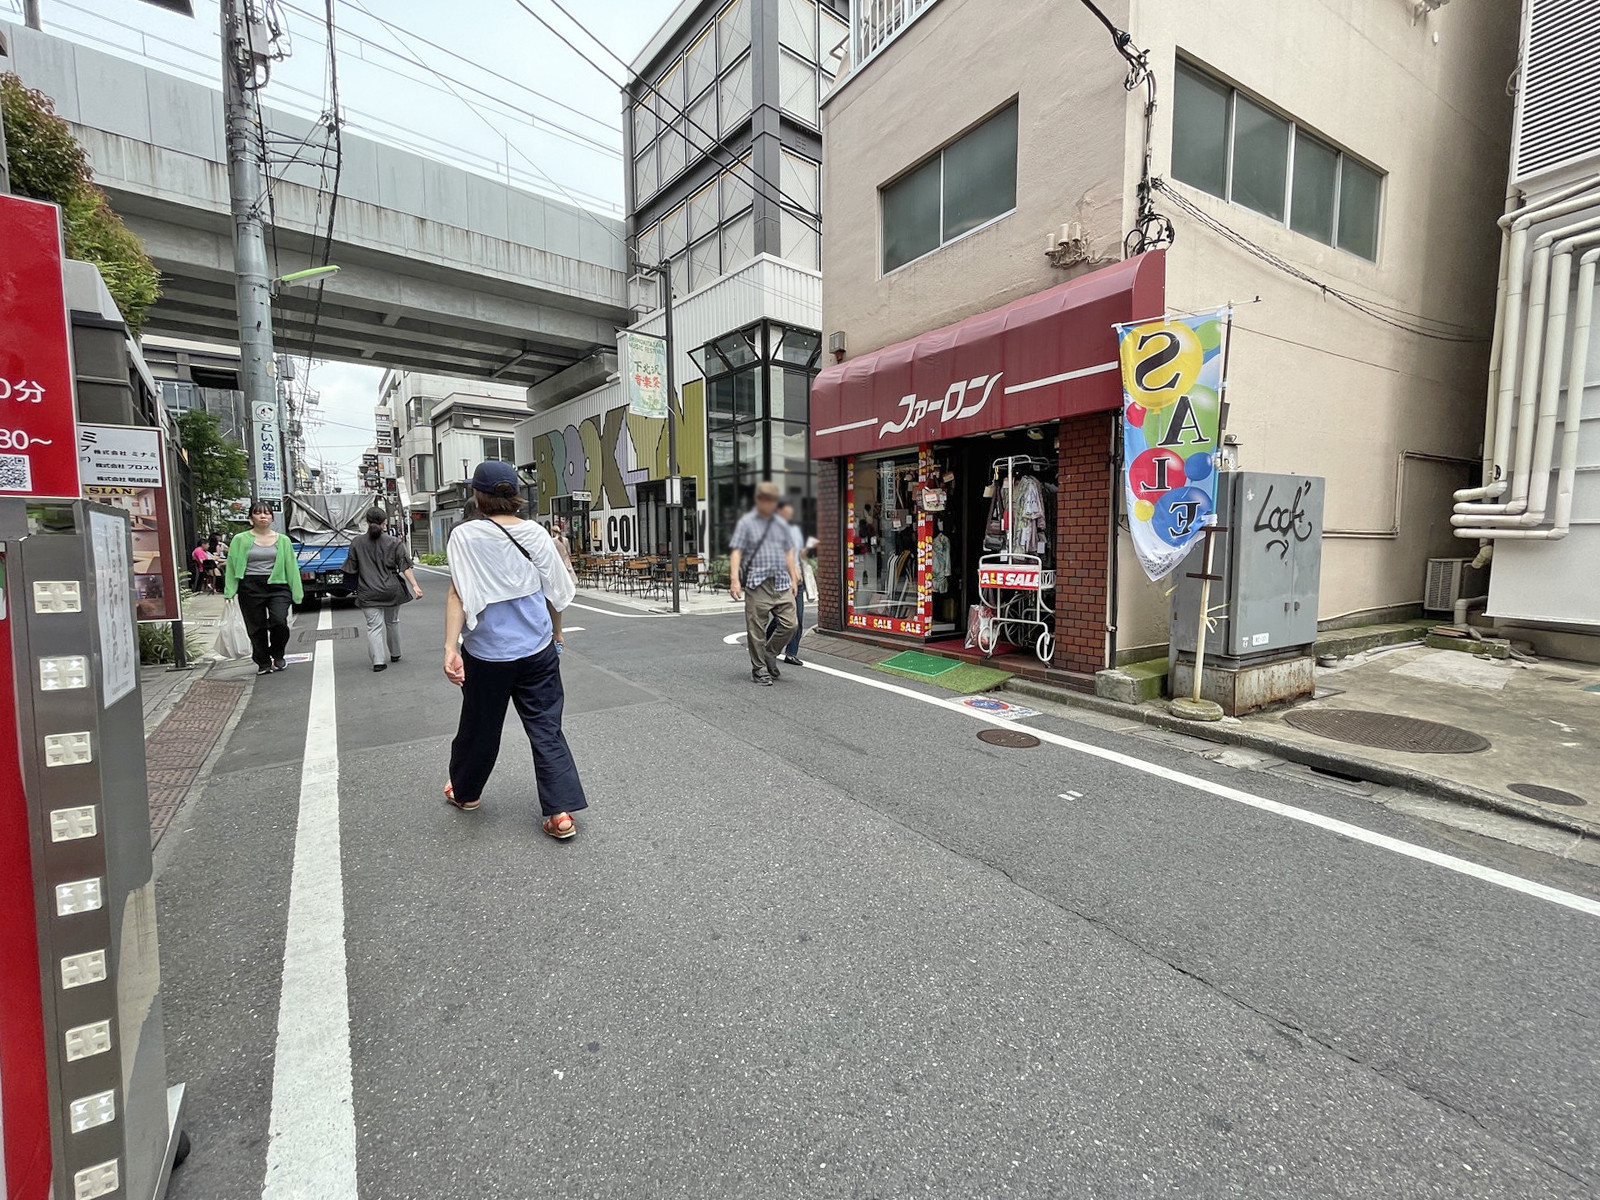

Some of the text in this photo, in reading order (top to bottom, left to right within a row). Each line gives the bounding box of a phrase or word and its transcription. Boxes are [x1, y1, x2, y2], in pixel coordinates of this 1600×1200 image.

[879, 371, 1003, 440] ファーロン
[261, 423, 276, 481] こいぬま歯科
[918, 451, 926, 482] SALE
[85, 487, 133, 495] SIAN
[925, 536, 933, 566] SALE
[849, 615, 921, 634] SALE SALE SALE
